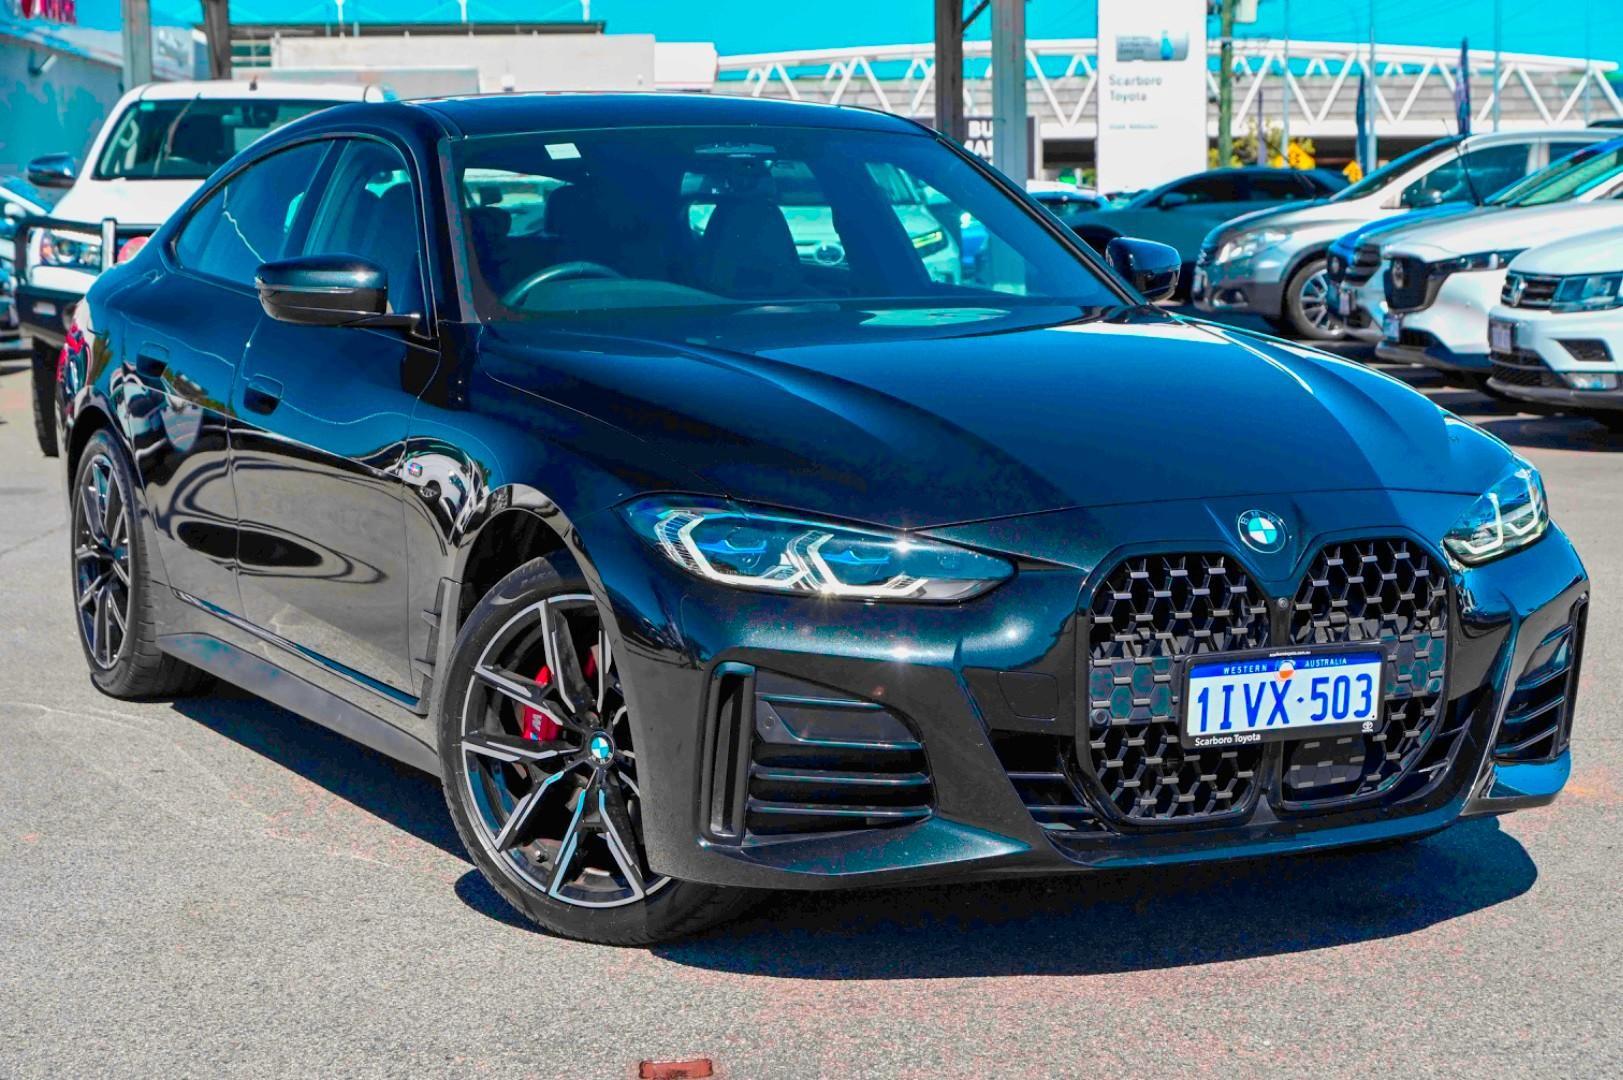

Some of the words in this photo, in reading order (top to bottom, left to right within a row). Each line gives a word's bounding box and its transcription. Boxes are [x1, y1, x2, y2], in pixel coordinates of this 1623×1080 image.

[1108, 73, 1163, 87] Scarboro
[1109, 89, 1148, 104] Toyota
[1223, 663, 1268, 675] WESTERN
[1304, 657, 1348, 668] AUSTRALIA
[1194, 736, 1233, 747] Scarboro
[1233, 732, 1262, 745] Toyota
